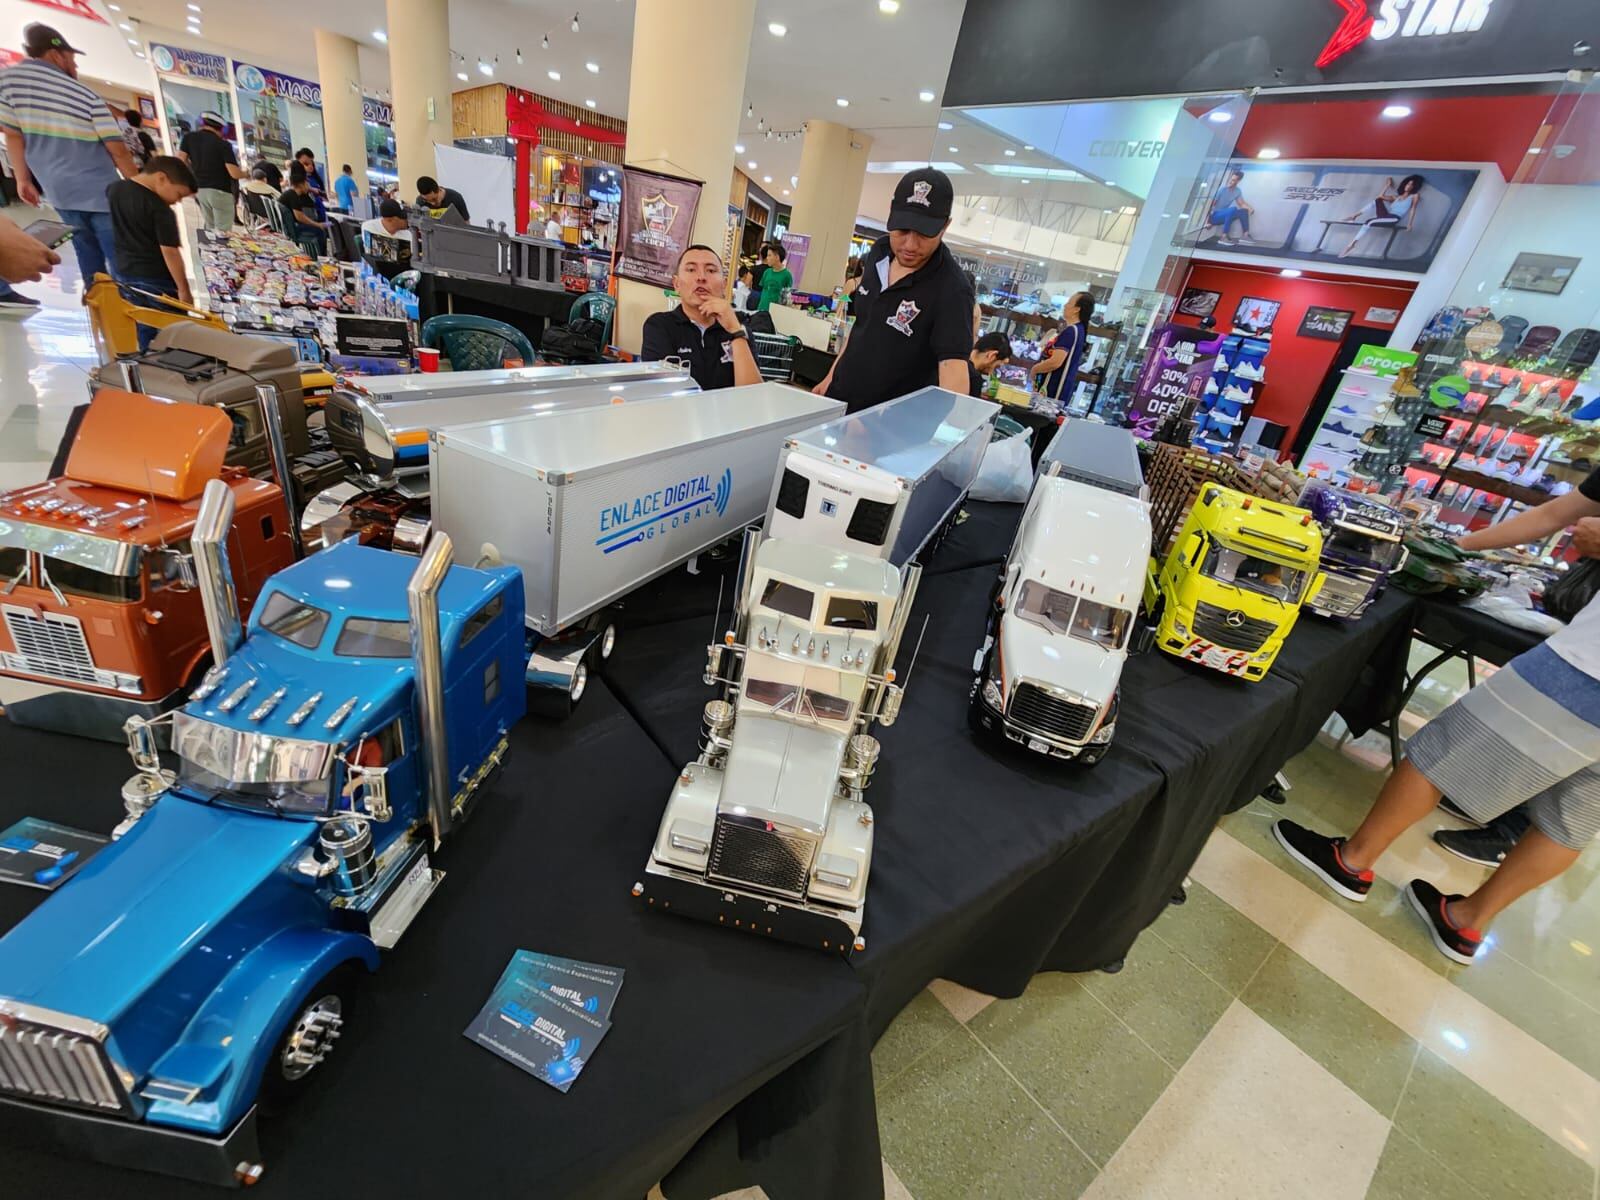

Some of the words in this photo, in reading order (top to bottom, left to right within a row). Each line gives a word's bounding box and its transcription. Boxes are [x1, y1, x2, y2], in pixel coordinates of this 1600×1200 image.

[963, 262, 1005, 277] MUSICAL
[1161, 368, 1189, 384] 30%
[1151, 382, 1187, 399] 40%
[600, 491, 662, 532] ENLACE
[664, 474, 712, 507] DIGITAL
[646, 505, 712, 540] GLOBAL
[550, 984, 582, 1002] DIGITAL
[561, 1002, 603, 1029] Especializado
[534, 1016, 567, 1041] DIGITAL
